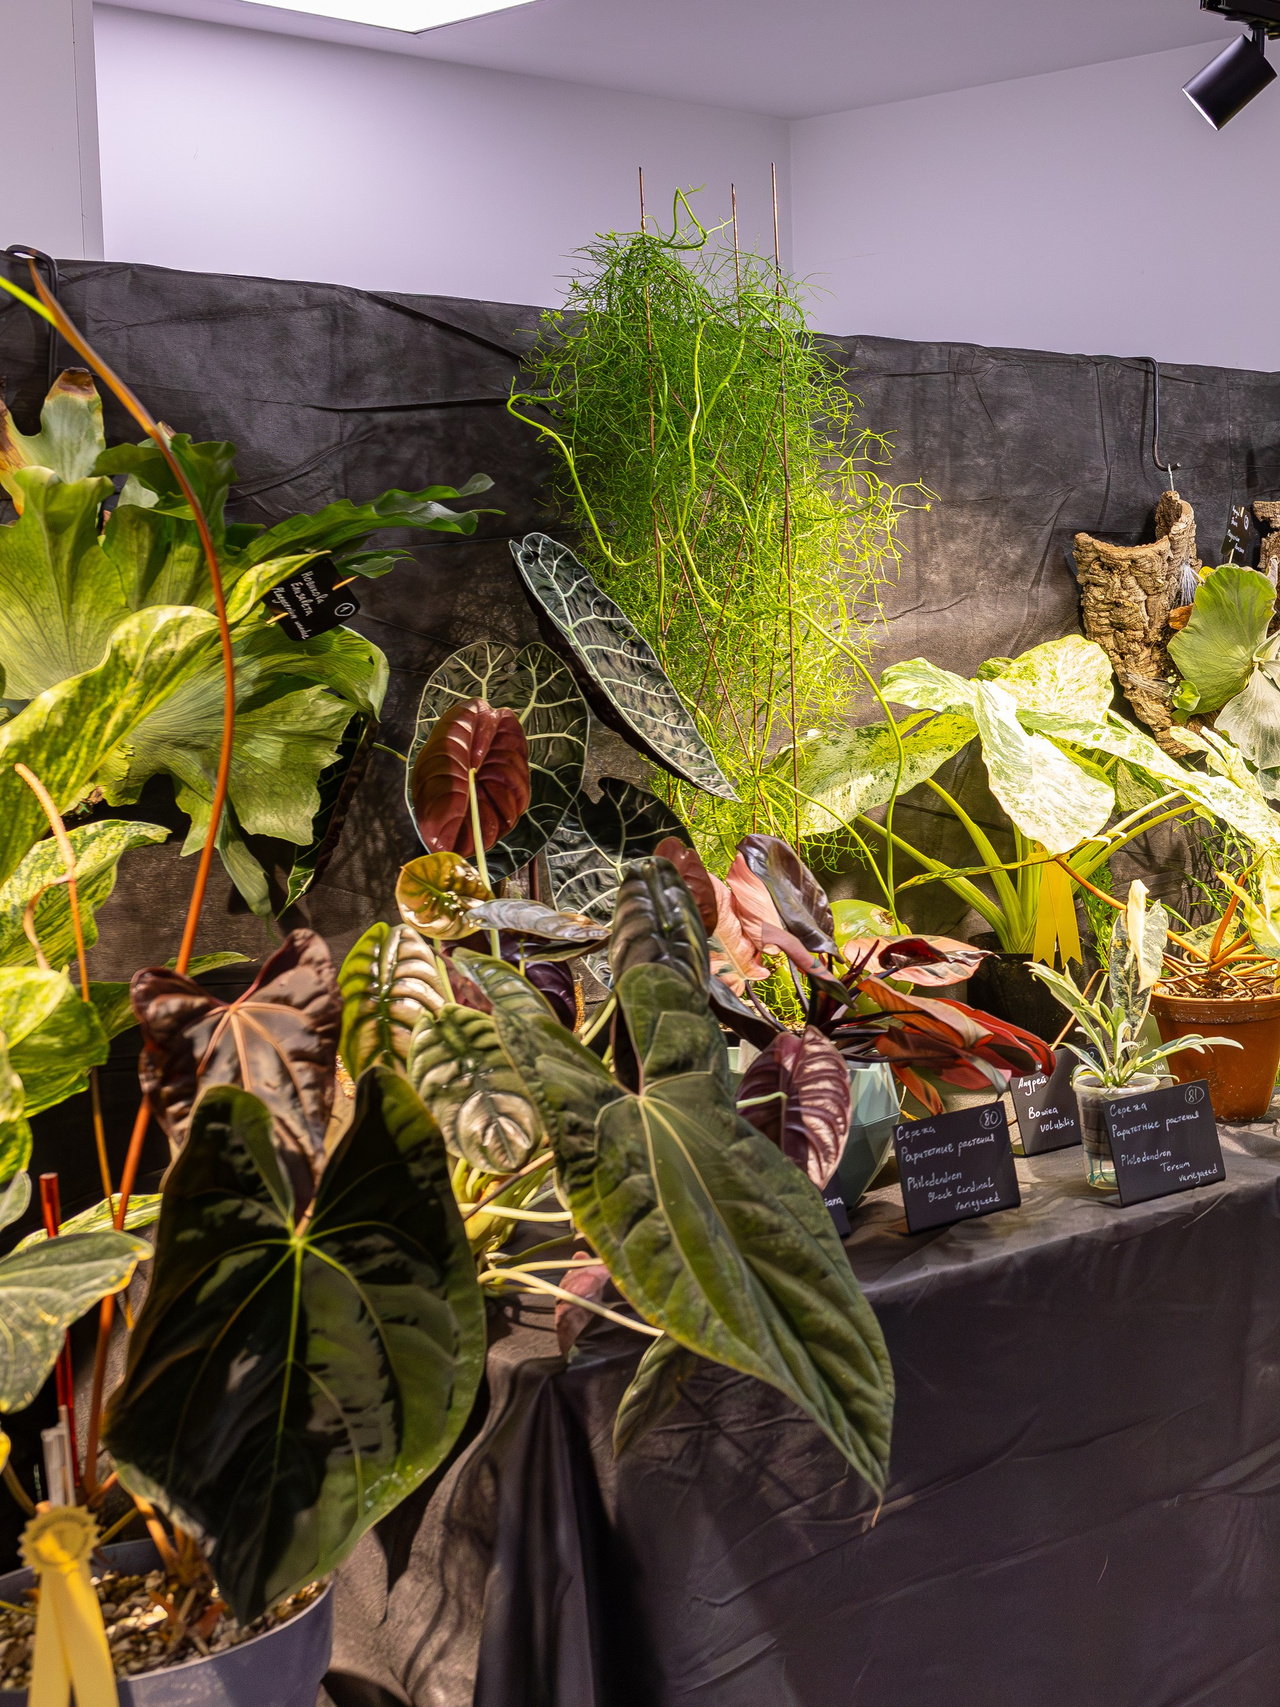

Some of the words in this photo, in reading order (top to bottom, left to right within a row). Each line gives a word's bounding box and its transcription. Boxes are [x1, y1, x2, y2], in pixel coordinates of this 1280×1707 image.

[291, 582, 314, 617] Елизавета
[1018, 1076, 1047, 1096] Андрей
[1028, 1106, 1058, 1119] Bowiea
[1110, 1103, 1148, 1118] Сережа
[897, 1126, 936, 1143] Сережа
[1112, 1121, 1160, 1141] Раритетные
[1166, 1111, 1199, 1132] растения
[901, 1143, 954, 1165] Раритетные
[958, 1133, 995, 1157] растения
[1121, 1149, 1172, 1167] Philodendron
[907, 1172, 962, 1192] Philodendron
[957, 1177, 994, 1195] Cardinal
